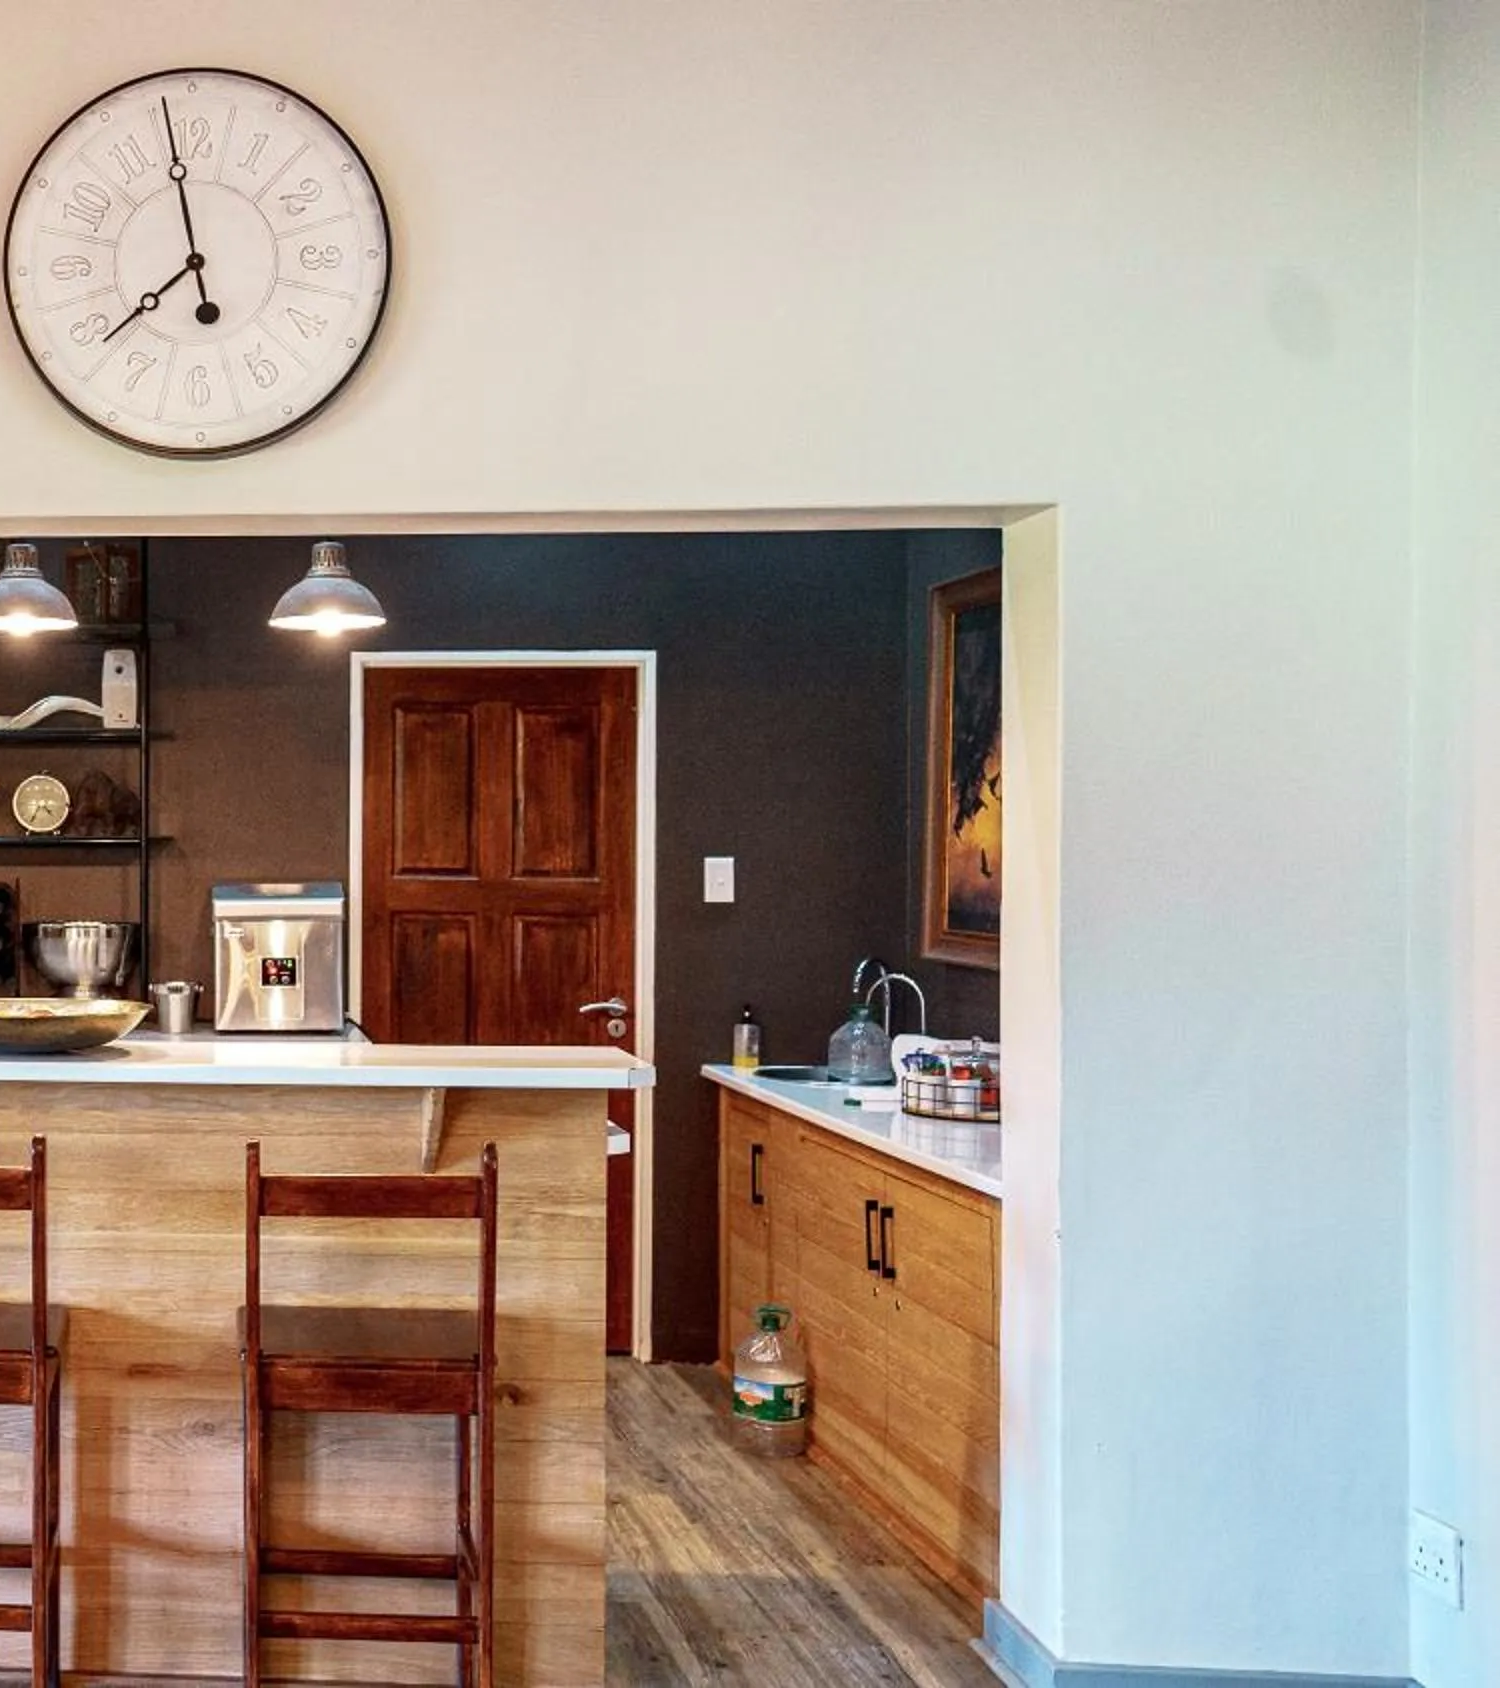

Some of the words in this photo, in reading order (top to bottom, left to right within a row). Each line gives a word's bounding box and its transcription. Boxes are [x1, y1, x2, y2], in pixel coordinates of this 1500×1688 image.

[108, 134, 156, 184] 11
[174, 117, 213, 160] 12
[238, 132, 270, 175] 1
[63, 182, 111, 232] 10
[279, 178, 322, 216] 2
[50, 255, 92, 280] 9
[300, 245, 342, 270] 3
[69, 312, 110, 346] 8
[286, 307, 328, 339] 4
[126, 351, 157, 392] 7
[187, 365, 210, 407] 6
[244, 343, 278, 388] 5
